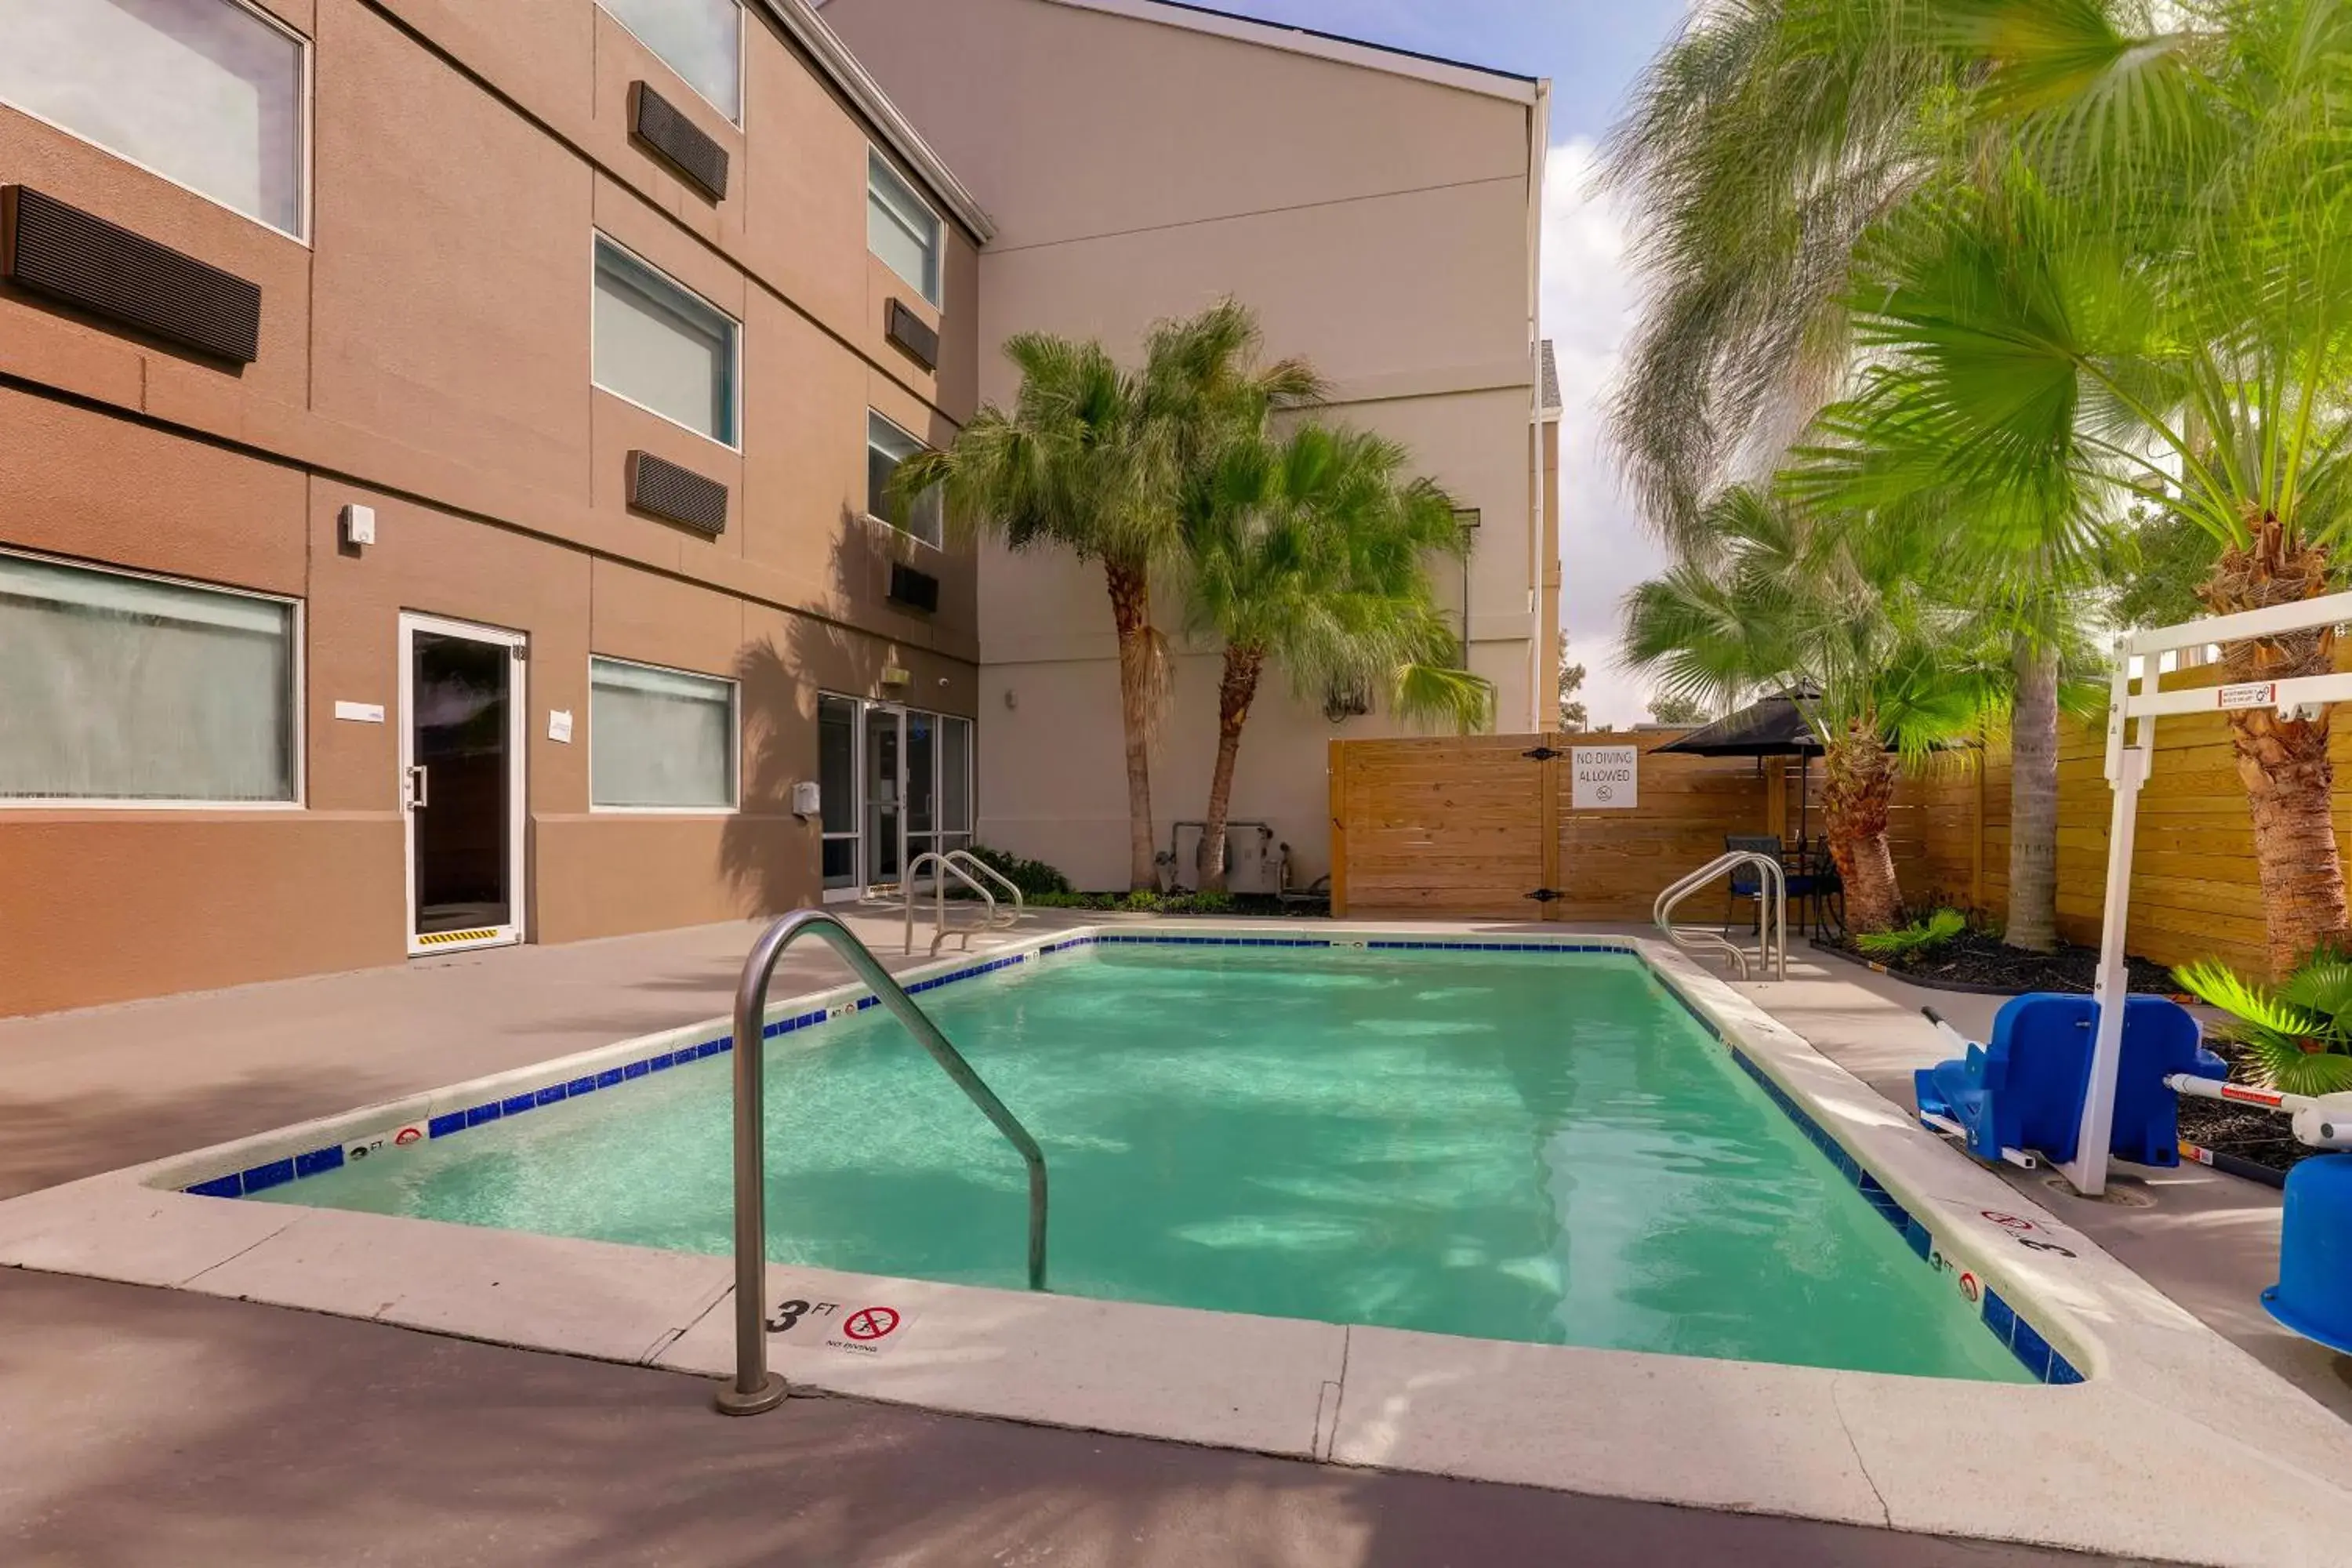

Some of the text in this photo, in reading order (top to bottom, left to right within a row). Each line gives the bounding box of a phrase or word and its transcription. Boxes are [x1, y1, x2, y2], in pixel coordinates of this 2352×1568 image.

[1577, 751, 1632, 764] NO DIVING
[1580, 769, 1630, 782] ALLOWED
[765, 1299, 840, 1333] 3 FT
[844, 1342, 877, 1352] DIVING
